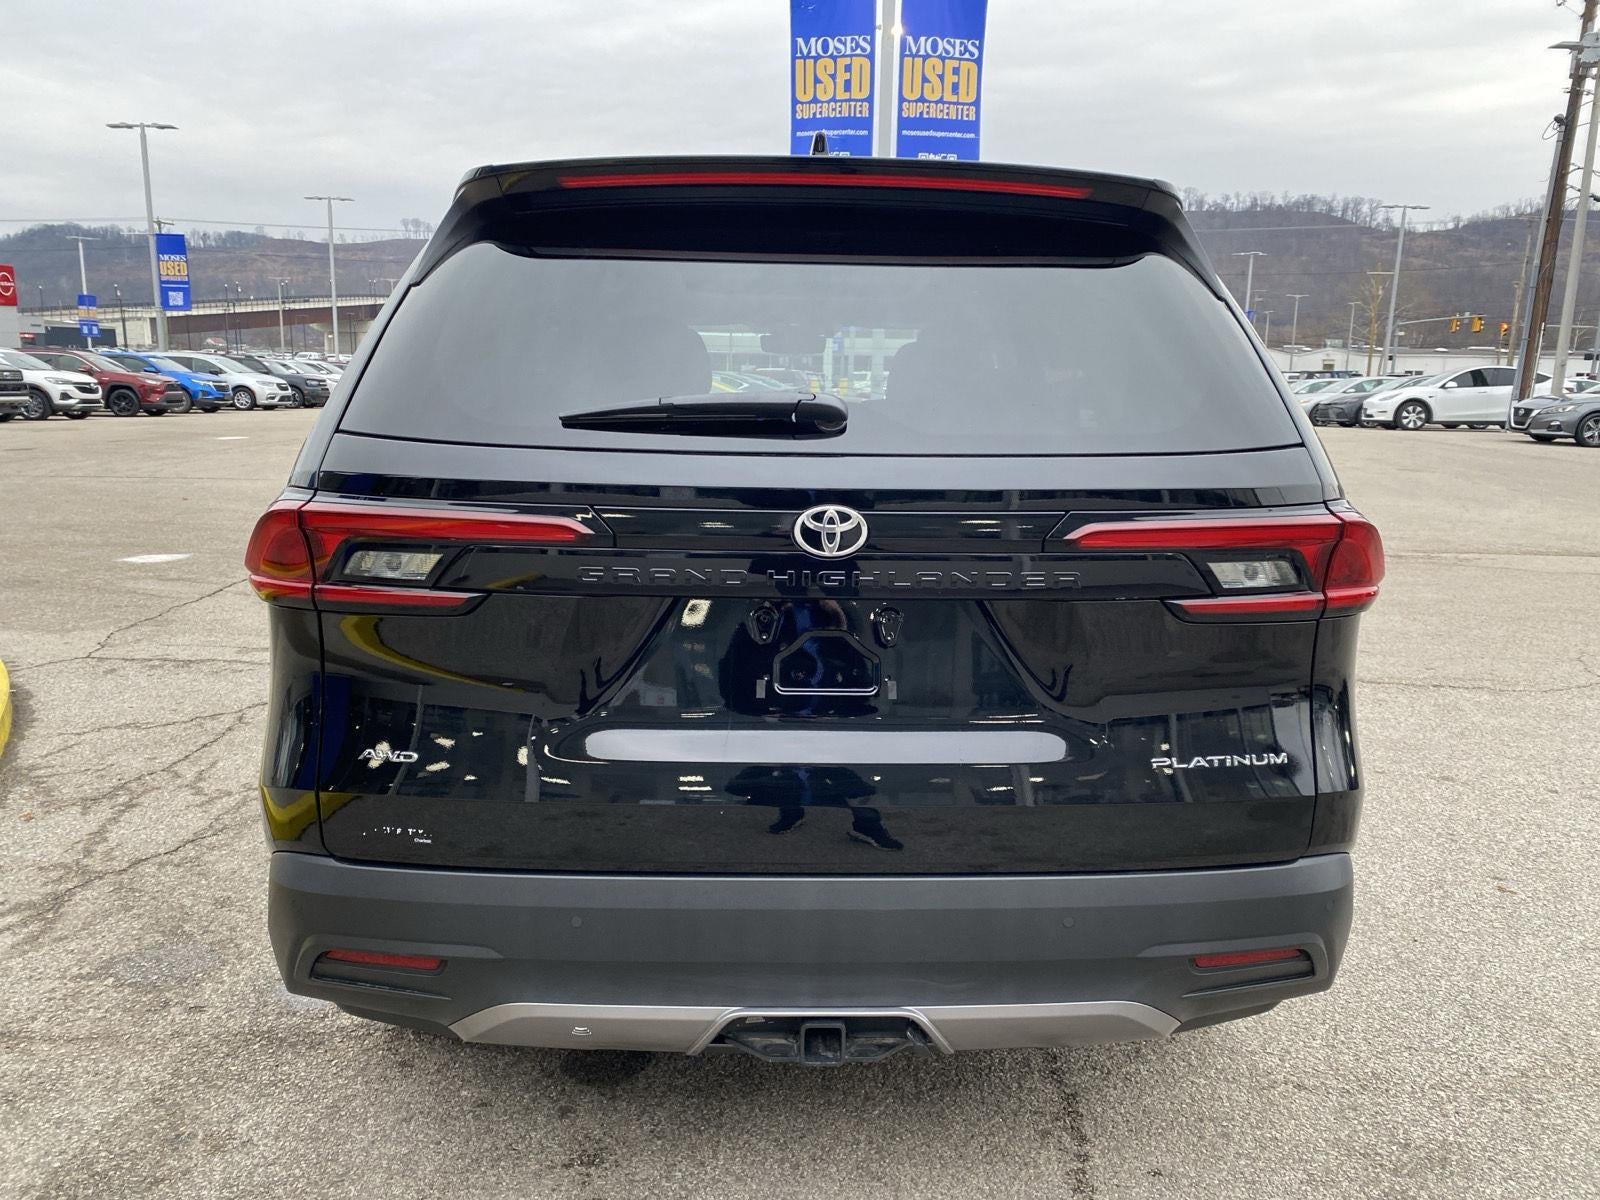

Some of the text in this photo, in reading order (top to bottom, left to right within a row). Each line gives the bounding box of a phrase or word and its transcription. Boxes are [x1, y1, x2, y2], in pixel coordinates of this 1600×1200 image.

[796, 35, 871, 57] MOSES
[906, 35, 979, 60] MOSES
[795, 57, 871, 102] USED
[902, 57, 978, 103] USED
[796, 102, 869, 120] SUPERCENTER
[902, 102, 976, 121] SUPERCENTER
[796, 129, 868, 137] mosesusupercenter.com
[902, 129, 976, 139] mosesusedsupercenter.com
[159, 254, 187, 262] MOSES
[159, 261, 187, 275] USED
[577, 566, 1082, 589] GRAND HIGHLANDER
[358, 749, 419, 762] AWD
[1150, 752, 1288, 769] PLATINUM
